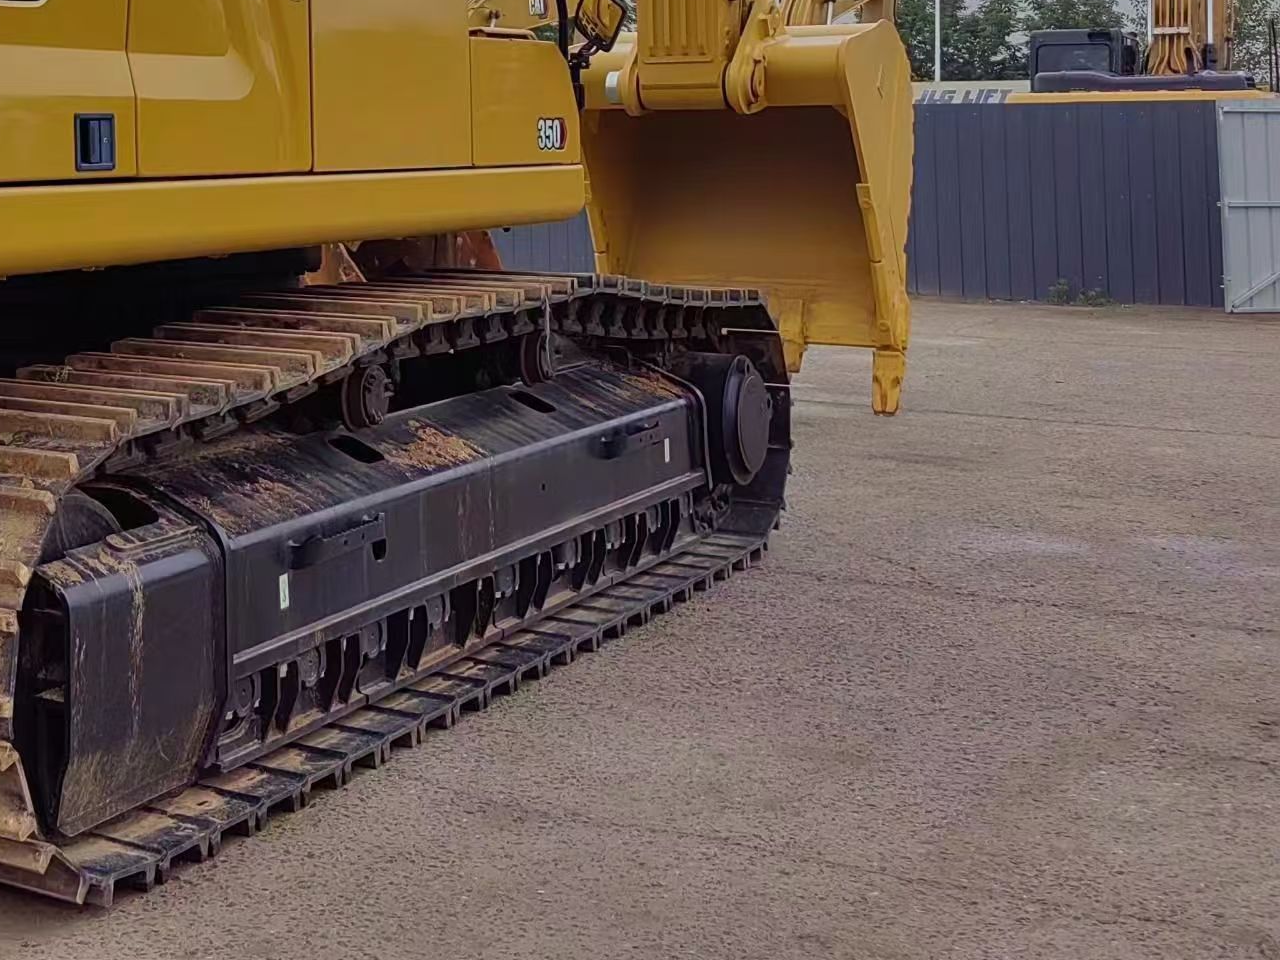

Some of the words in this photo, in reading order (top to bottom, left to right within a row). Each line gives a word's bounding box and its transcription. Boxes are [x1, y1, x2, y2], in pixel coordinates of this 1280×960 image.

[913, 89, 957, 104] JLG
[960, 89, 1013, 104] LIFT
[537, 118, 561, 149] 350
